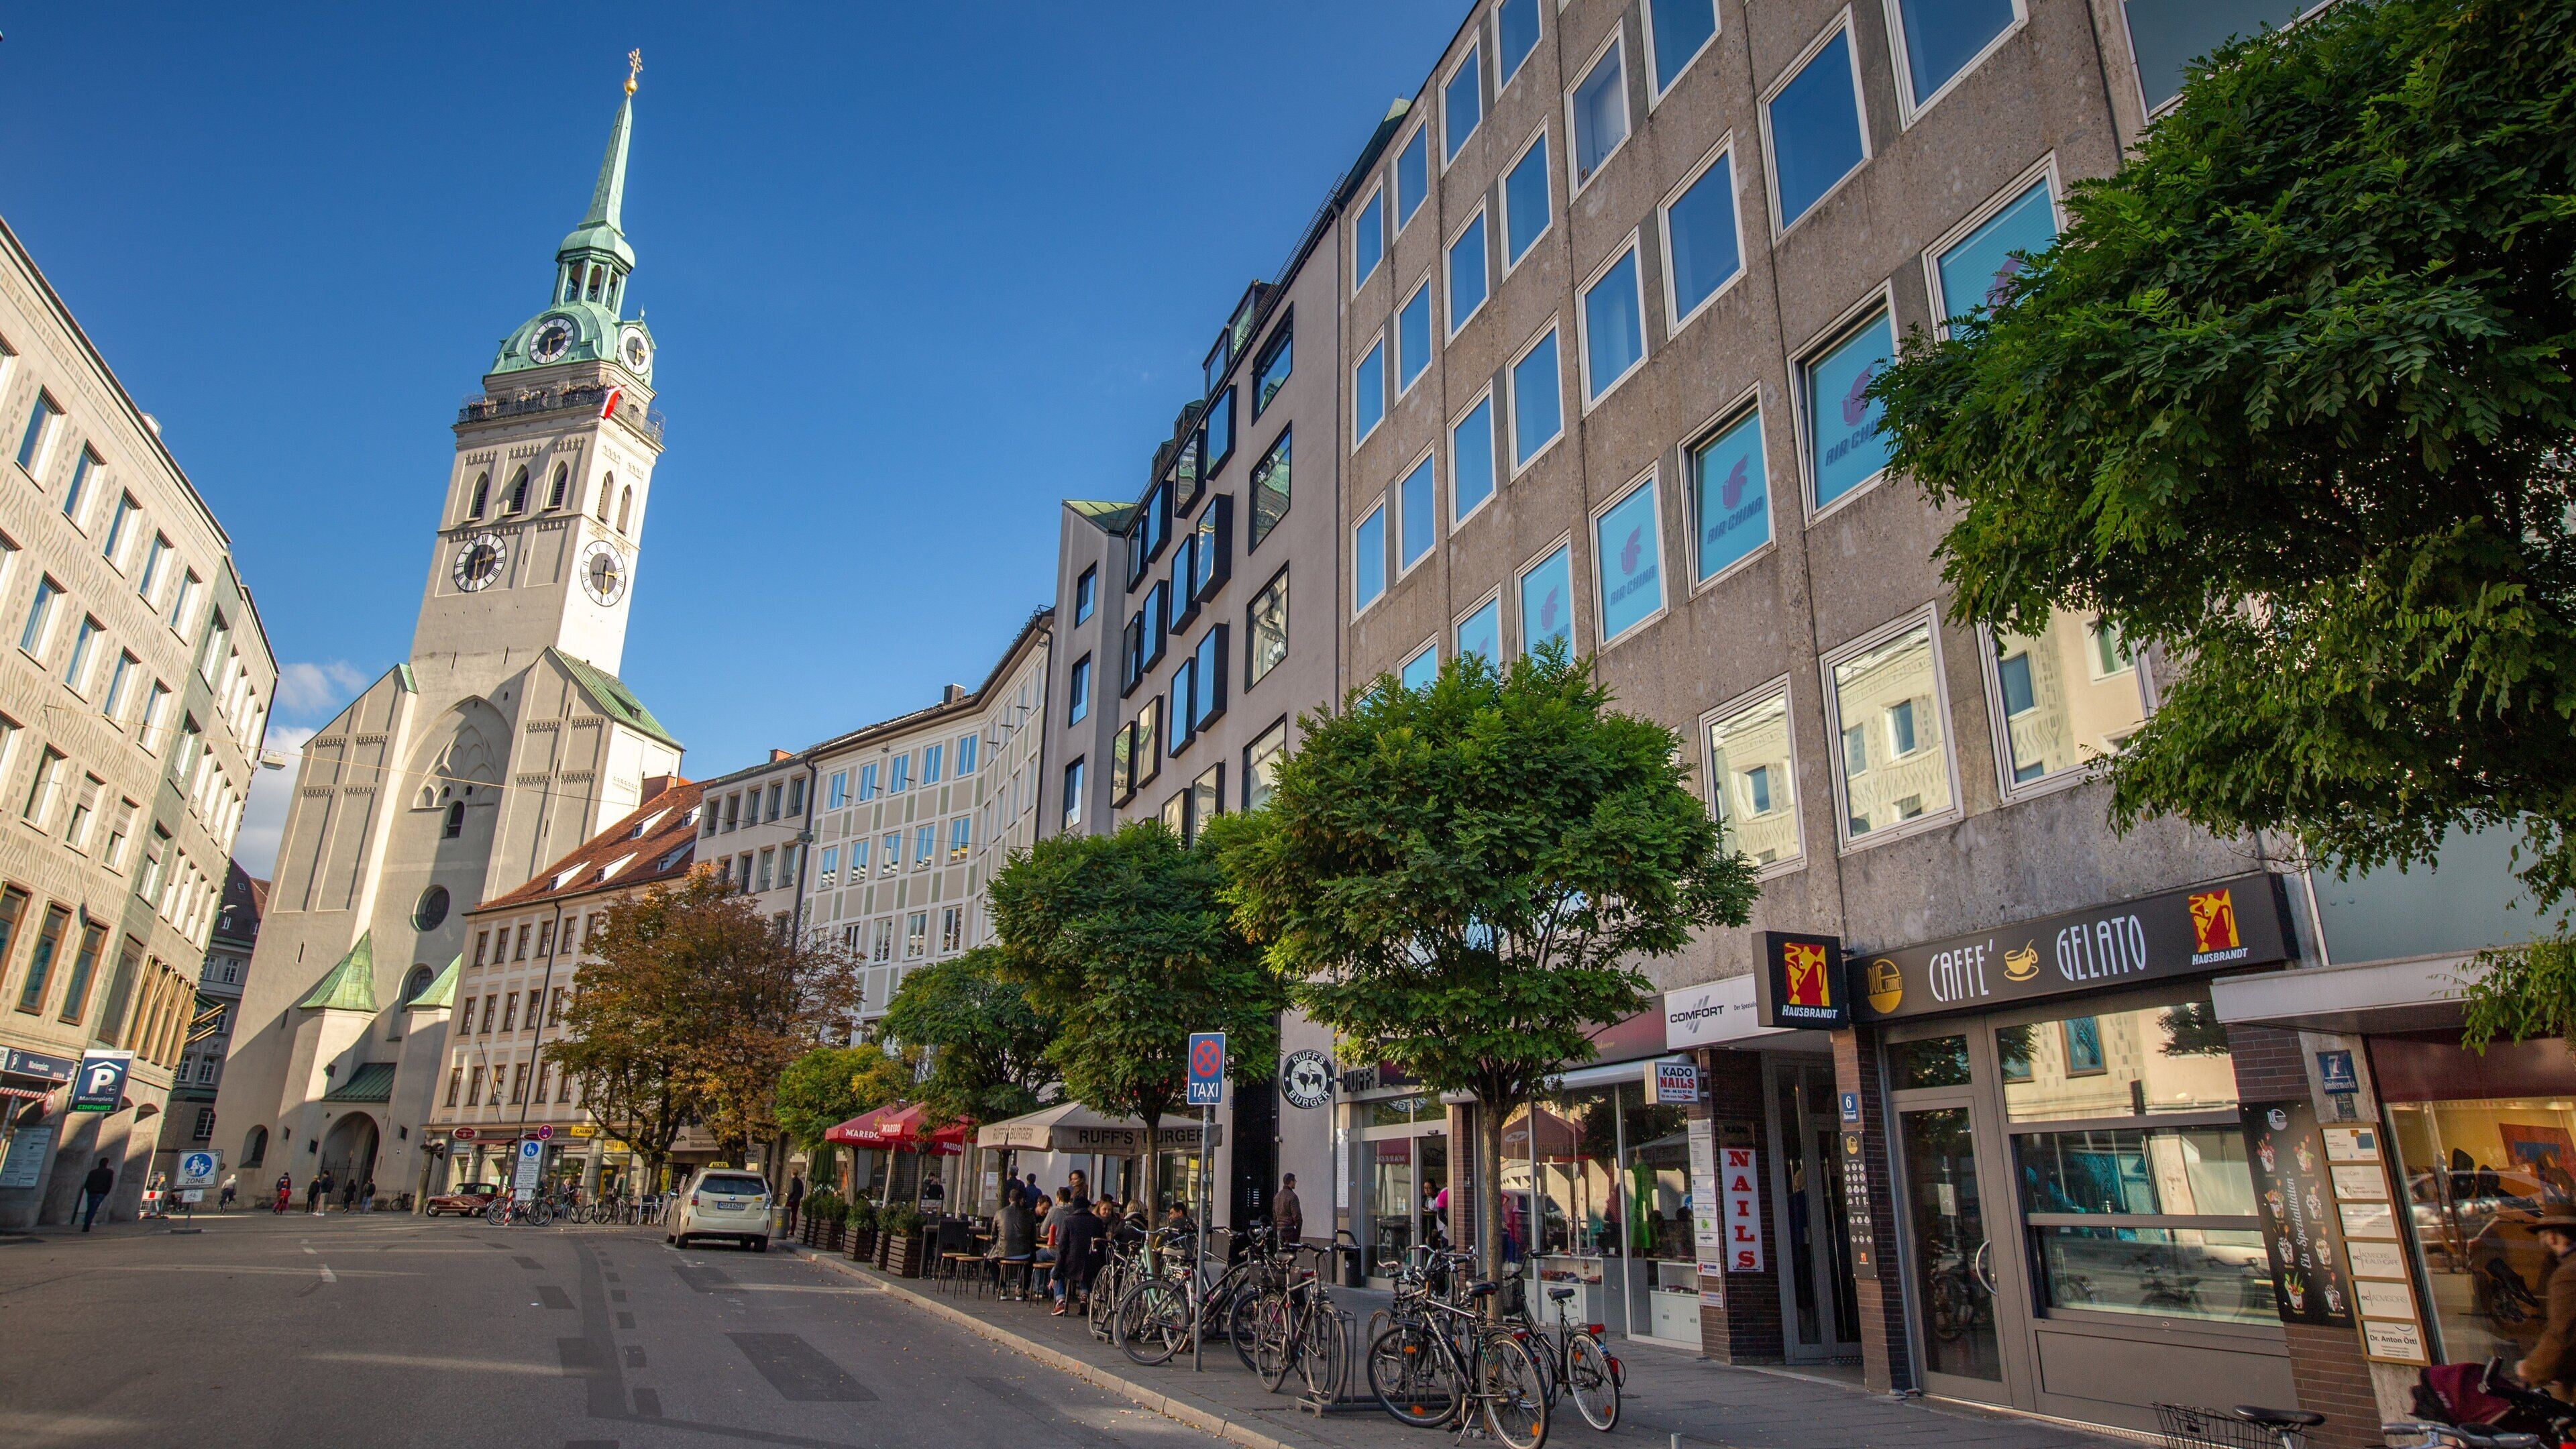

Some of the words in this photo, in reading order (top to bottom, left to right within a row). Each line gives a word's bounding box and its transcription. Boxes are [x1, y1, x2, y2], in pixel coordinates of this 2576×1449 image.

[1825, 439, 1848, 467] AIR
[1707, 521, 1726, 545] AIR
[1727, 496, 1764, 531] CHINA
[1611, 585, 1626, 606] AIR
[1627, 565, 1656, 594] CHINA
[2056, 914, 2146, 981] GELATO
[2192, 947, 2249, 966] HAUSBRANDT
[1868, 965, 1886, 995] DUE
[1670, 1005, 1725, 1024] COMFORT
[1782, 1004, 1838, 1020] HAUSBRANDT
[1292, 1051, 1326, 1065] RUFF'S
[2328, 1055, 2340, 1073] 7
[1662, 1067, 1693, 1077] KADO
[89, 1068, 115, 1094] P
[1660, 1077, 1695, 1089] NAILS
[1191, 1082, 1219, 1097] TAXI
[1289, 1090, 1330, 1107] BURGER
[1845, 1095, 1852, 1109] 6
[881, 1123, 901, 1133] MAREDO
[1010, 1128, 1034, 1141] BURGER
[1079, 1129, 1134, 1145] RUFF'S
[943, 1142, 961, 1152] MAREDO
[1728, 1150, 1756, 1269] NAILS
[2372, 1294, 2408, 1303] ADVISORS
[2381, 1336, 2403, 1344] Anton
[2403, 1336, 2418, 1345] Öttl
